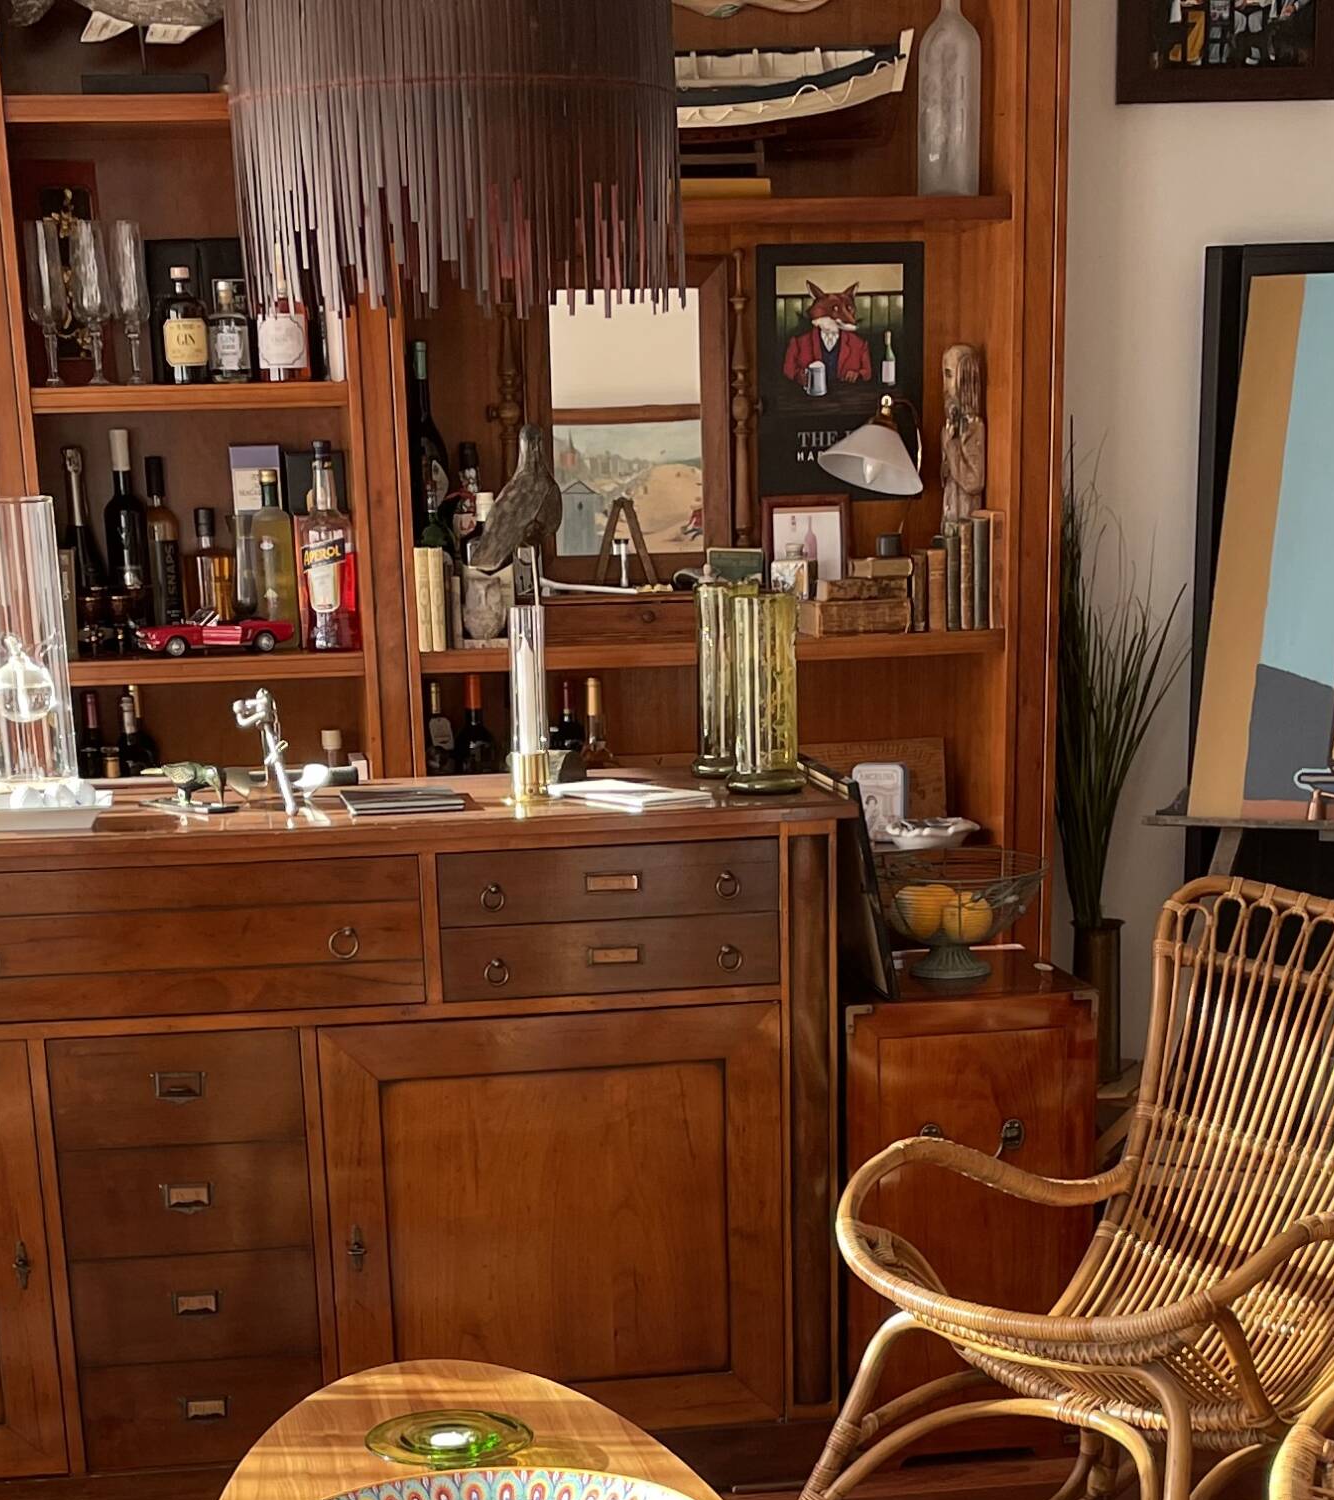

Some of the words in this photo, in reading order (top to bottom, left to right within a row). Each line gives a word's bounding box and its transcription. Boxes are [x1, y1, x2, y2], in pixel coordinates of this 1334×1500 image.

[176, 333, 196, 346] GIN
[797, 430, 838, 448] THE
[303, 545, 342, 565] APEROL
